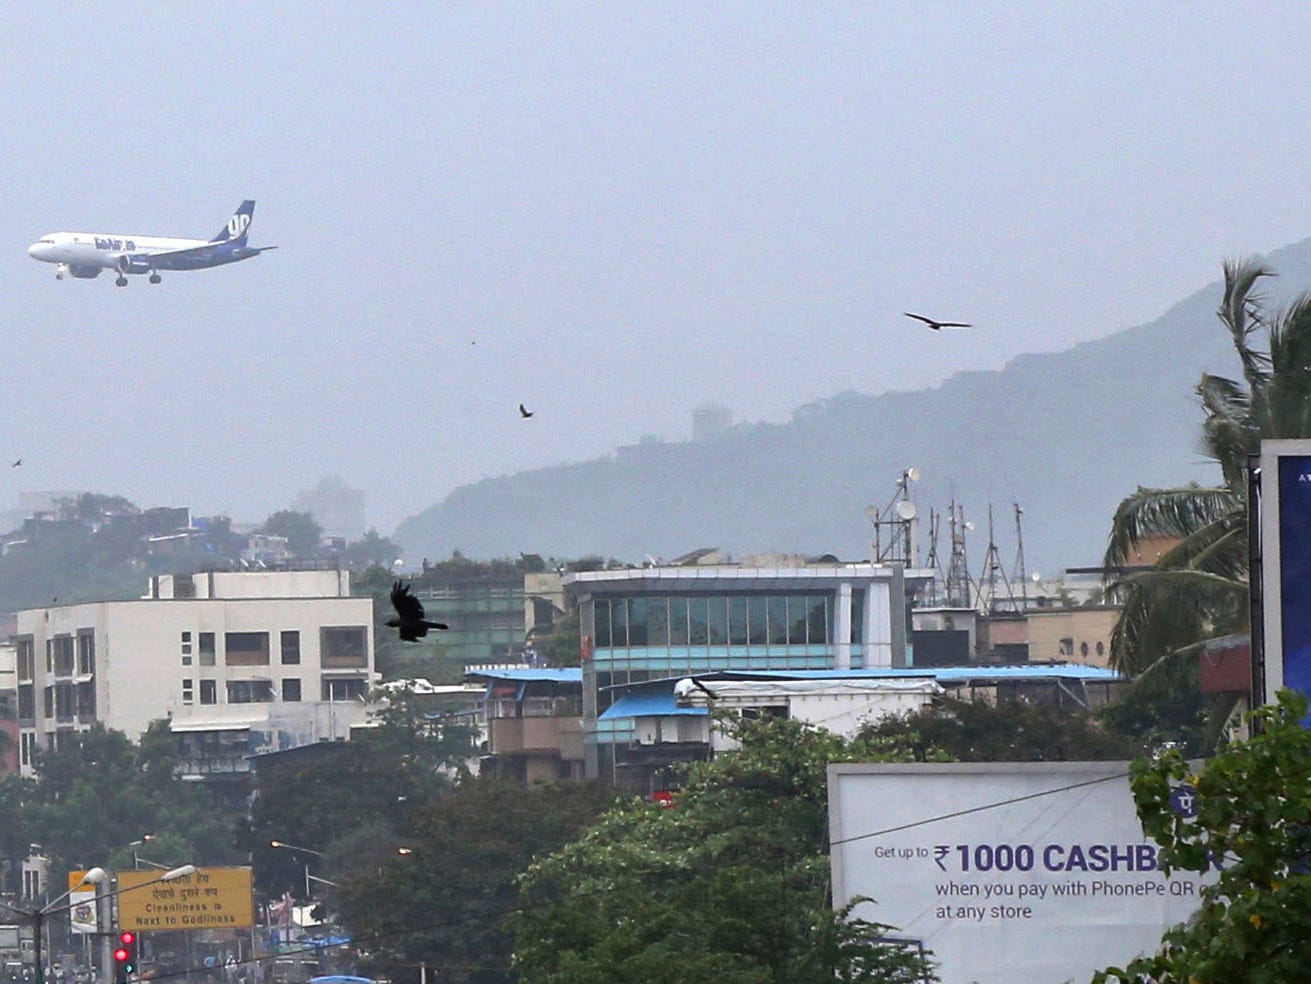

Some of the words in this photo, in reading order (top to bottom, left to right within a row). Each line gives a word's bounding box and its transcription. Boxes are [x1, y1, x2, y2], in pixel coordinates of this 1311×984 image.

[875, 846, 896, 858] Get
[899, 848, 914, 860] up
[916, 847, 929, 858] to
[1043, 844, 1225, 872] CASHBK
[936, 881, 980, 896] when
[983, 884, 1014, 900] you
[1019, 884, 1048, 900] pay
[1052, 881, 1088, 896] with
[1092, 881, 1165, 896] PhonePe
[1170, 881, 1195, 897] QR
[145, 903, 207, 913] Cleanliness
[936, 905, 951, 918] at
[955, 907, 986, 921] any
[991, 905, 1032, 919] store
[136, 916, 160, 925] Next
[166, 916, 176, 925] to
[183, 914, 236, 925] Godliness
